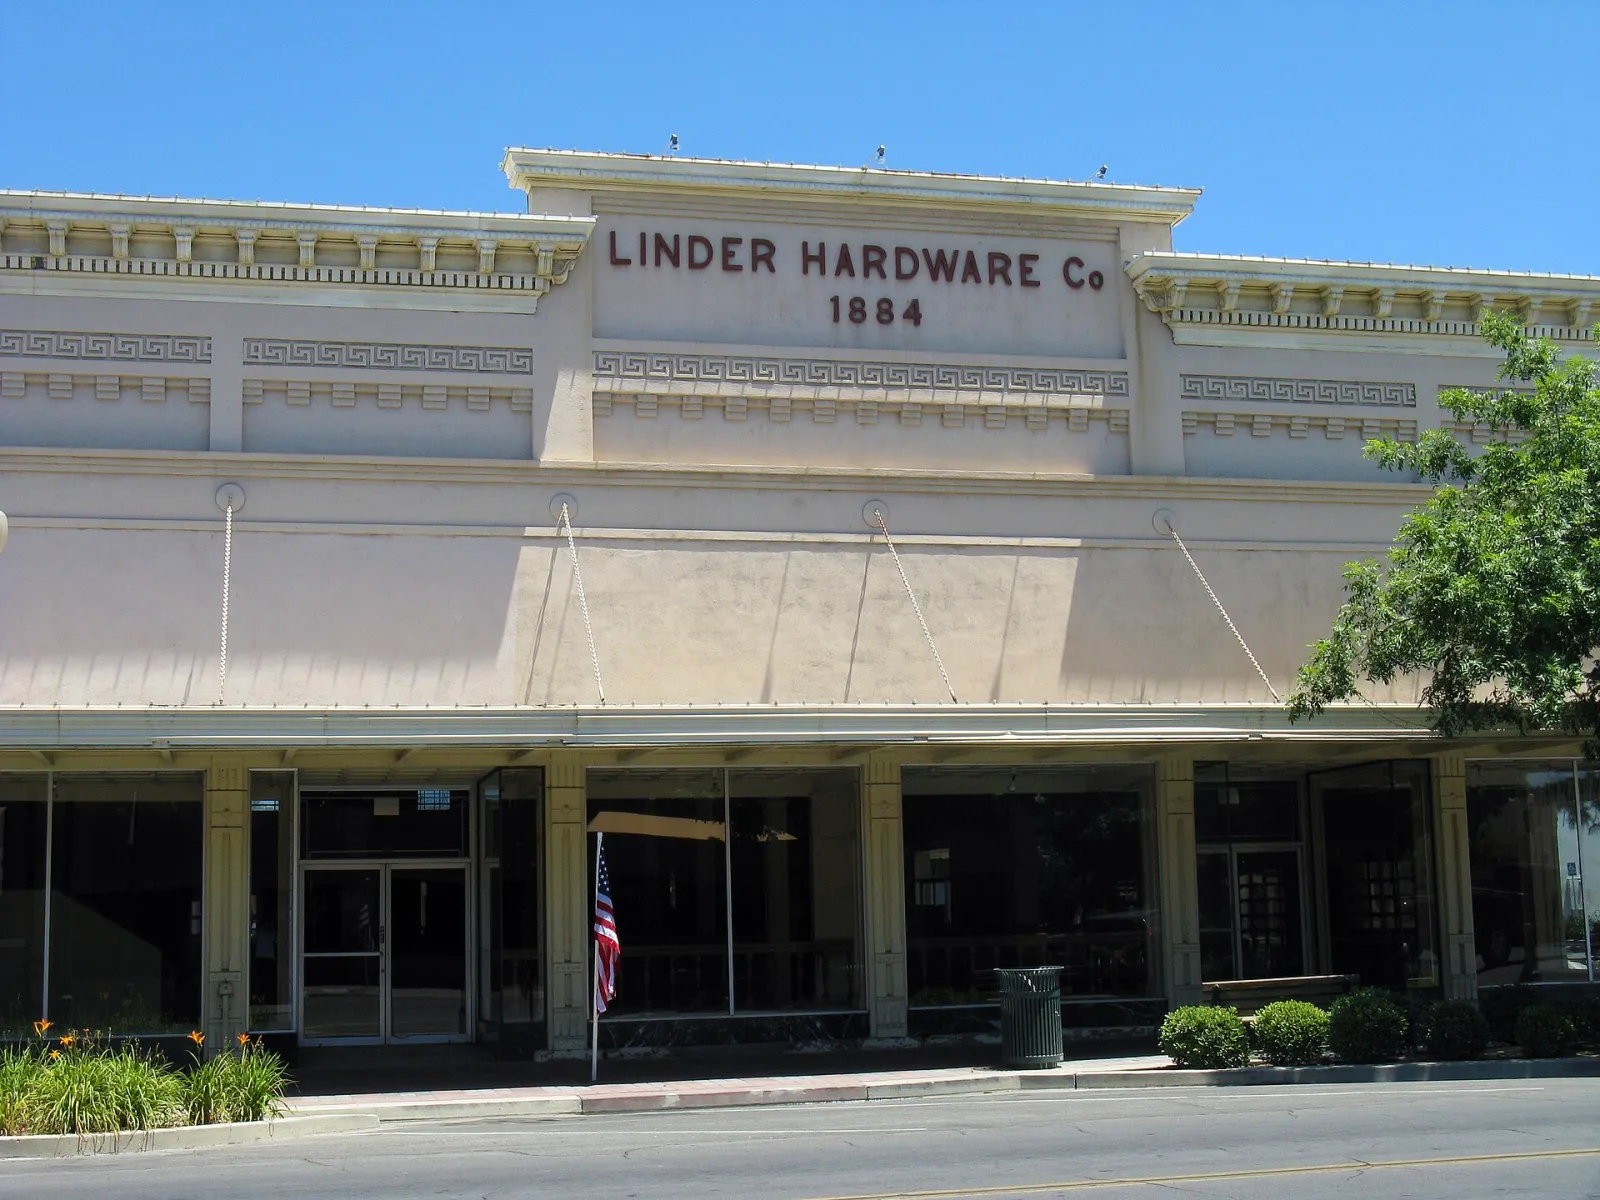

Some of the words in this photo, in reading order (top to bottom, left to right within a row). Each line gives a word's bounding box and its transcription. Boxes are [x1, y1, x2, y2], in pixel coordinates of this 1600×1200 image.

[610, 230, 776, 273] LINDER
[801, 241, 1041, 287] HARDWARE
[1063, 257, 1104, 290] Co
[830, 295, 923, 326] 1884
